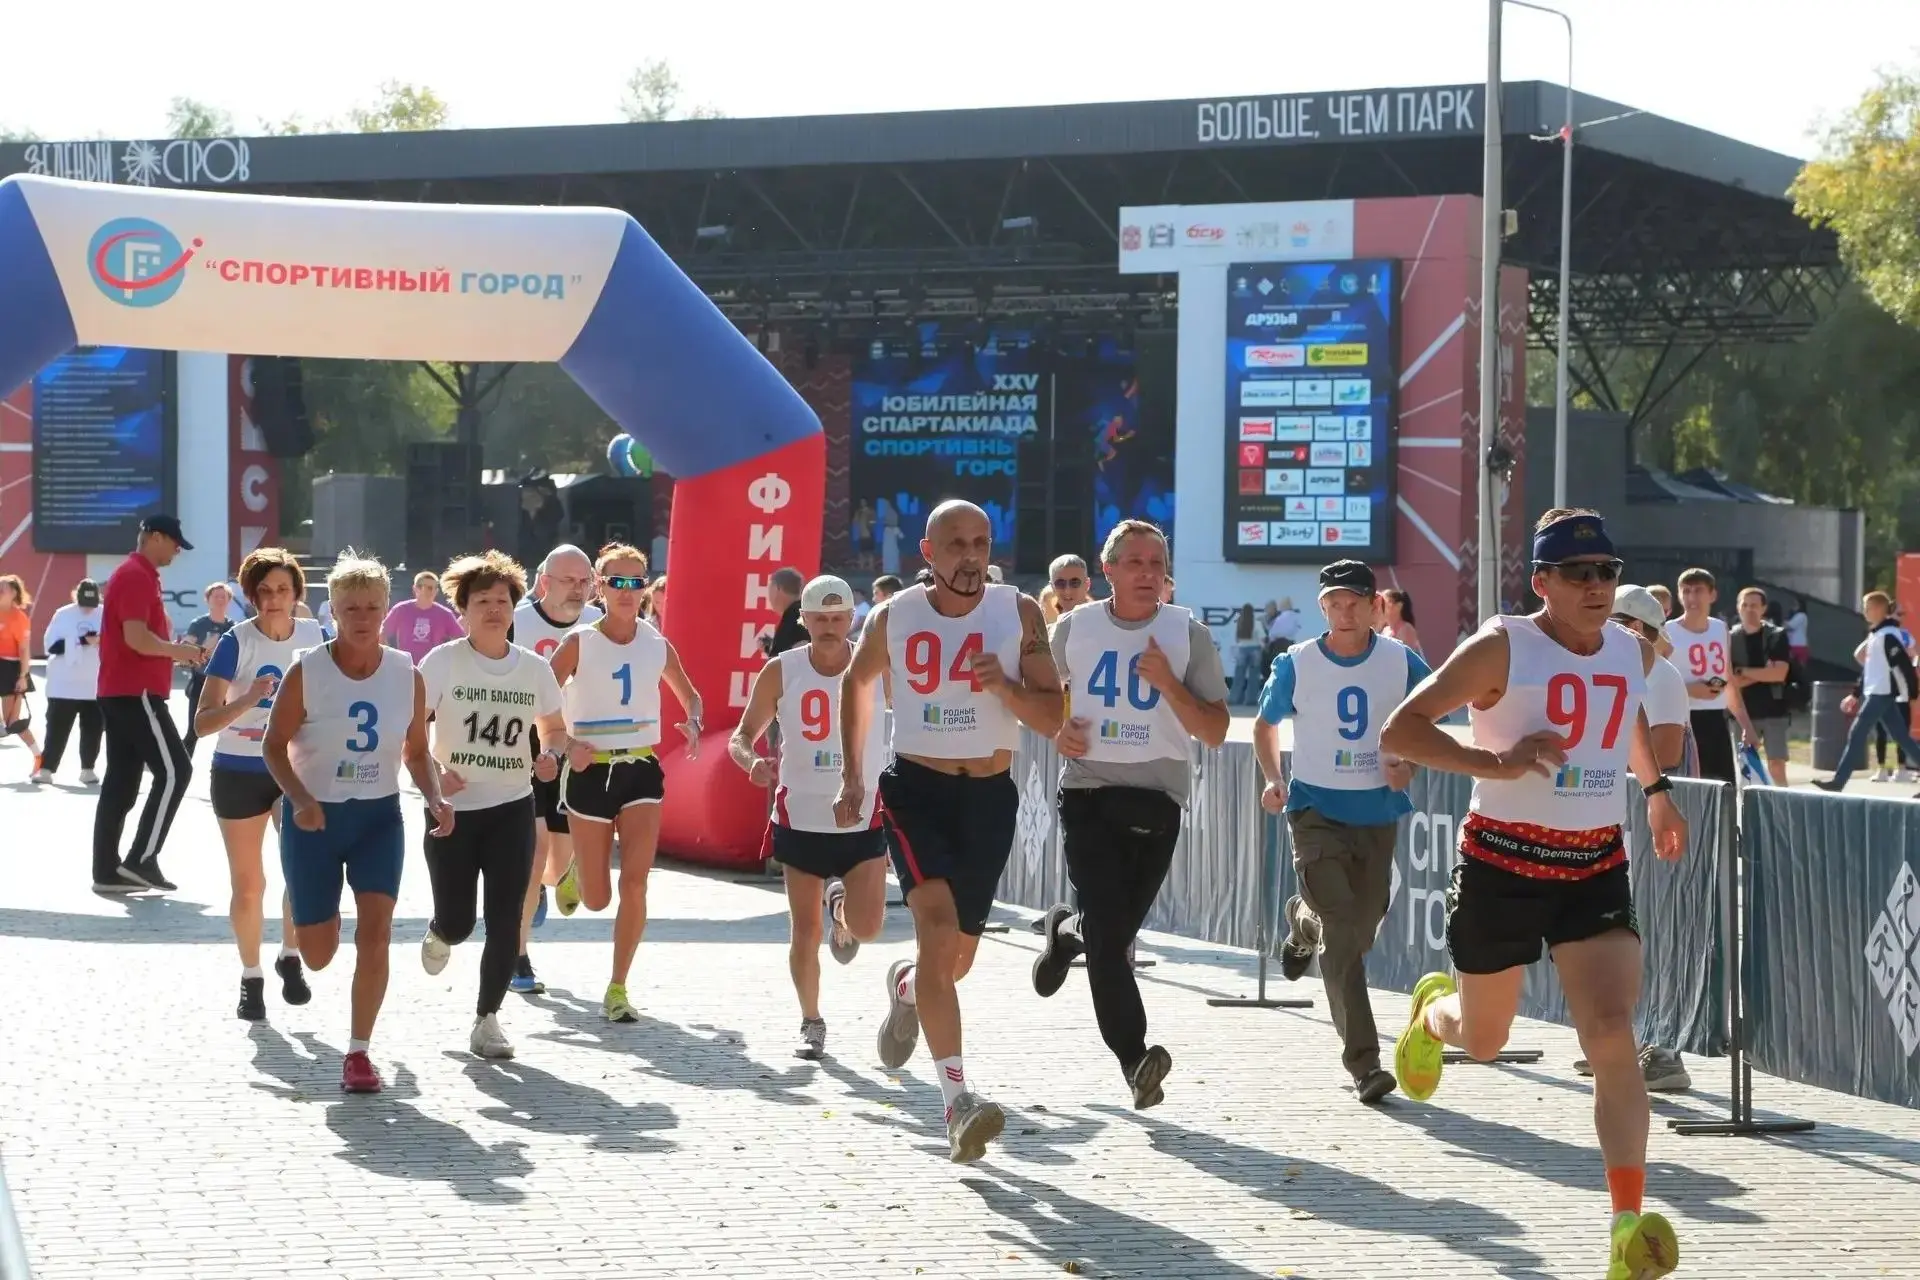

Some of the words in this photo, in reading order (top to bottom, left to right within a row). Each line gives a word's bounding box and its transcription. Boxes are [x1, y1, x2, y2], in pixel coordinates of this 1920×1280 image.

[1198, 98, 1321, 142] БОЛЬШЕ,
[1328, 95, 1389, 136] ЧЕМ
[1397, 89, 1475, 132] ПАРК
[1245, 311, 1298, 327] ДРУЗЬЯ
[993, 373, 1039, 391] XXV
[882, 391, 1038, 413] ЮБИЛЕЙНАЯ
[862, 415, 1039, 434] СПАРТАКИАДА
[956, 459, 1017, 476] ГОРО
[905, 631, 984, 694] 94
[1688, 641, 1725, 677] 93
[611, 663, 632, 706] 1
[1087, 650, 1161, 711] 40
[467, 687, 487, 703] ЦНП
[491, 689, 536, 707] БЛАГОВЕСТ
[943, 707, 976, 716] РОДНЫЕ
[943, 715, 977, 725] ГОРОДА
[1336, 685, 1369, 741] 9
[1546, 672, 1628, 751] 97
[346, 700, 379, 753] 3
[463, 710, 523, 748] 140
[1120, 723, 1151, 732] РОДНЫЕ
[1120, 731, 1150, 740] ГОРОДА
[449, 751, 524, 771] МУРОМЦЕВО
[1582, 778, 1615, 788] ГОРОДА
[1583, 768, 1617, 779] РОДНЫЕ
[1481, 831, 1518, 850] гонка
[1521, 844, 1530, 853] с
